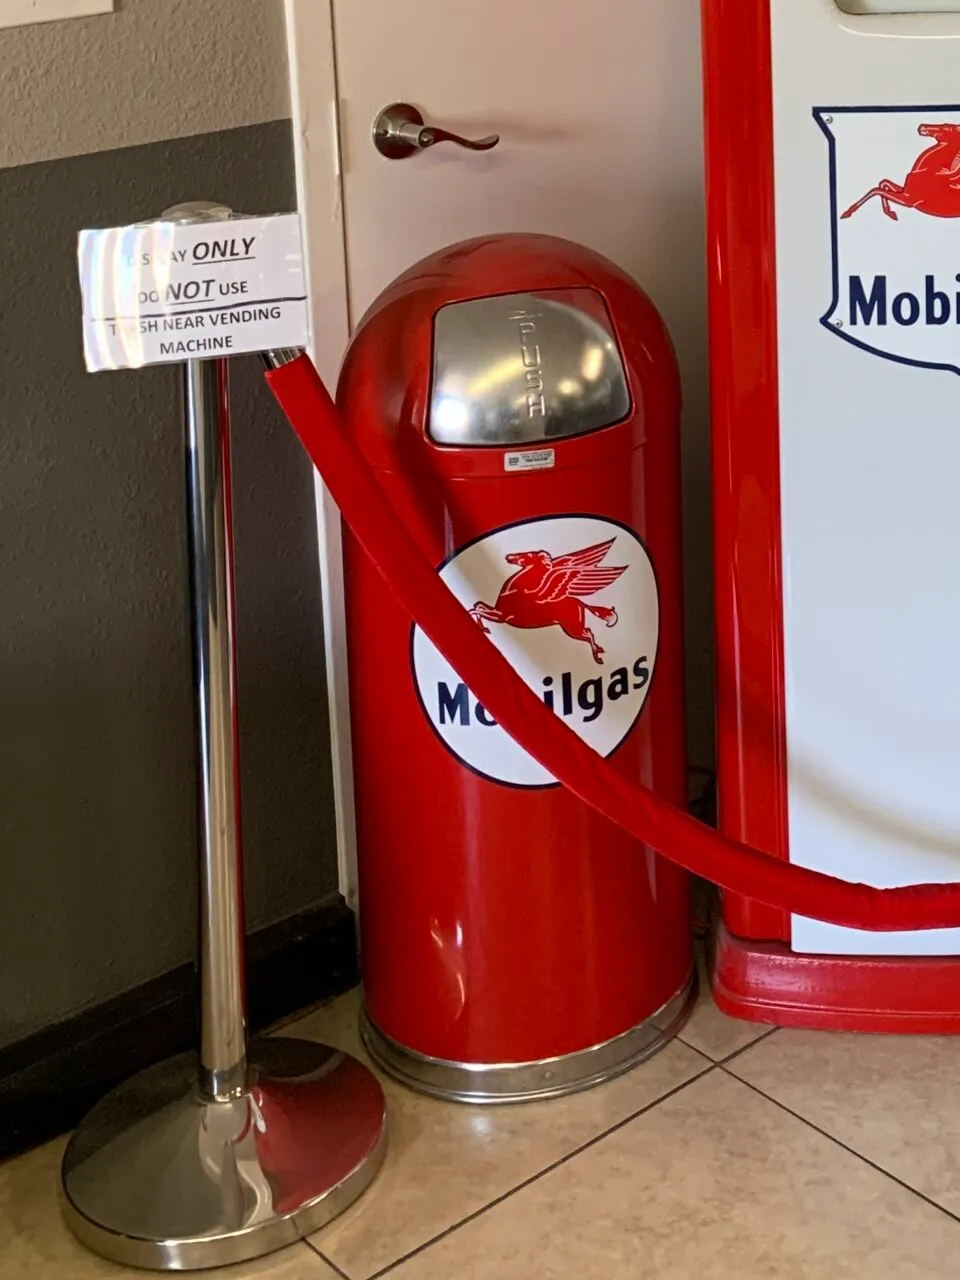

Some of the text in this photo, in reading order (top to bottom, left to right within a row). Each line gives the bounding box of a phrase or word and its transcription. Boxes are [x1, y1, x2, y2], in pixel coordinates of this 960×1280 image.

[192, 237, 256, 261] ONLY
[166, 279, 215, 302] NOT
[219, 281, 248, 296] USE
[109, 307, 281, 336] TSH NEAR VENDING
[160, 336, 233, 355] MACHINE
[519, 322, 546, 418] PUSH
[437, 656, 649, 726] Milgas
